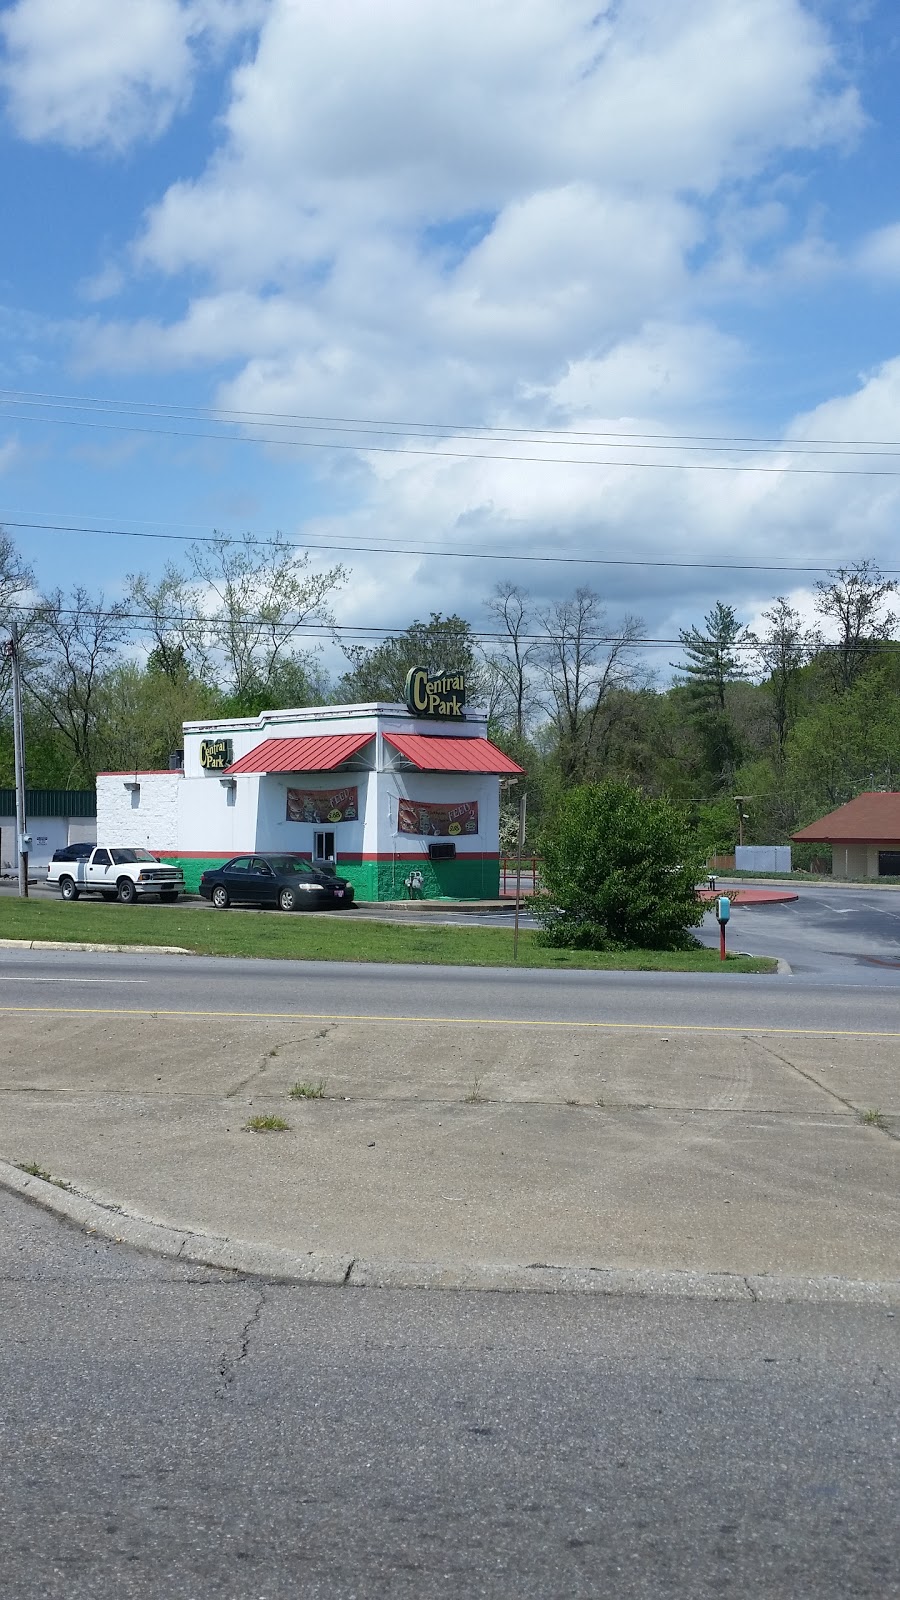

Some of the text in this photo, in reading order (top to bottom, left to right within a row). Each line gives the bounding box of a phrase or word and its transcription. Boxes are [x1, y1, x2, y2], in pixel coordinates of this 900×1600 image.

[414, 671, 464, 710] Central
[427, 694, 462, 716] Park
[200, 742, 225, 765] Central
[206, 755, 224, 768] Park
[448, 803, 471, 821] FEED
[469, 809, 475, 819] 2
